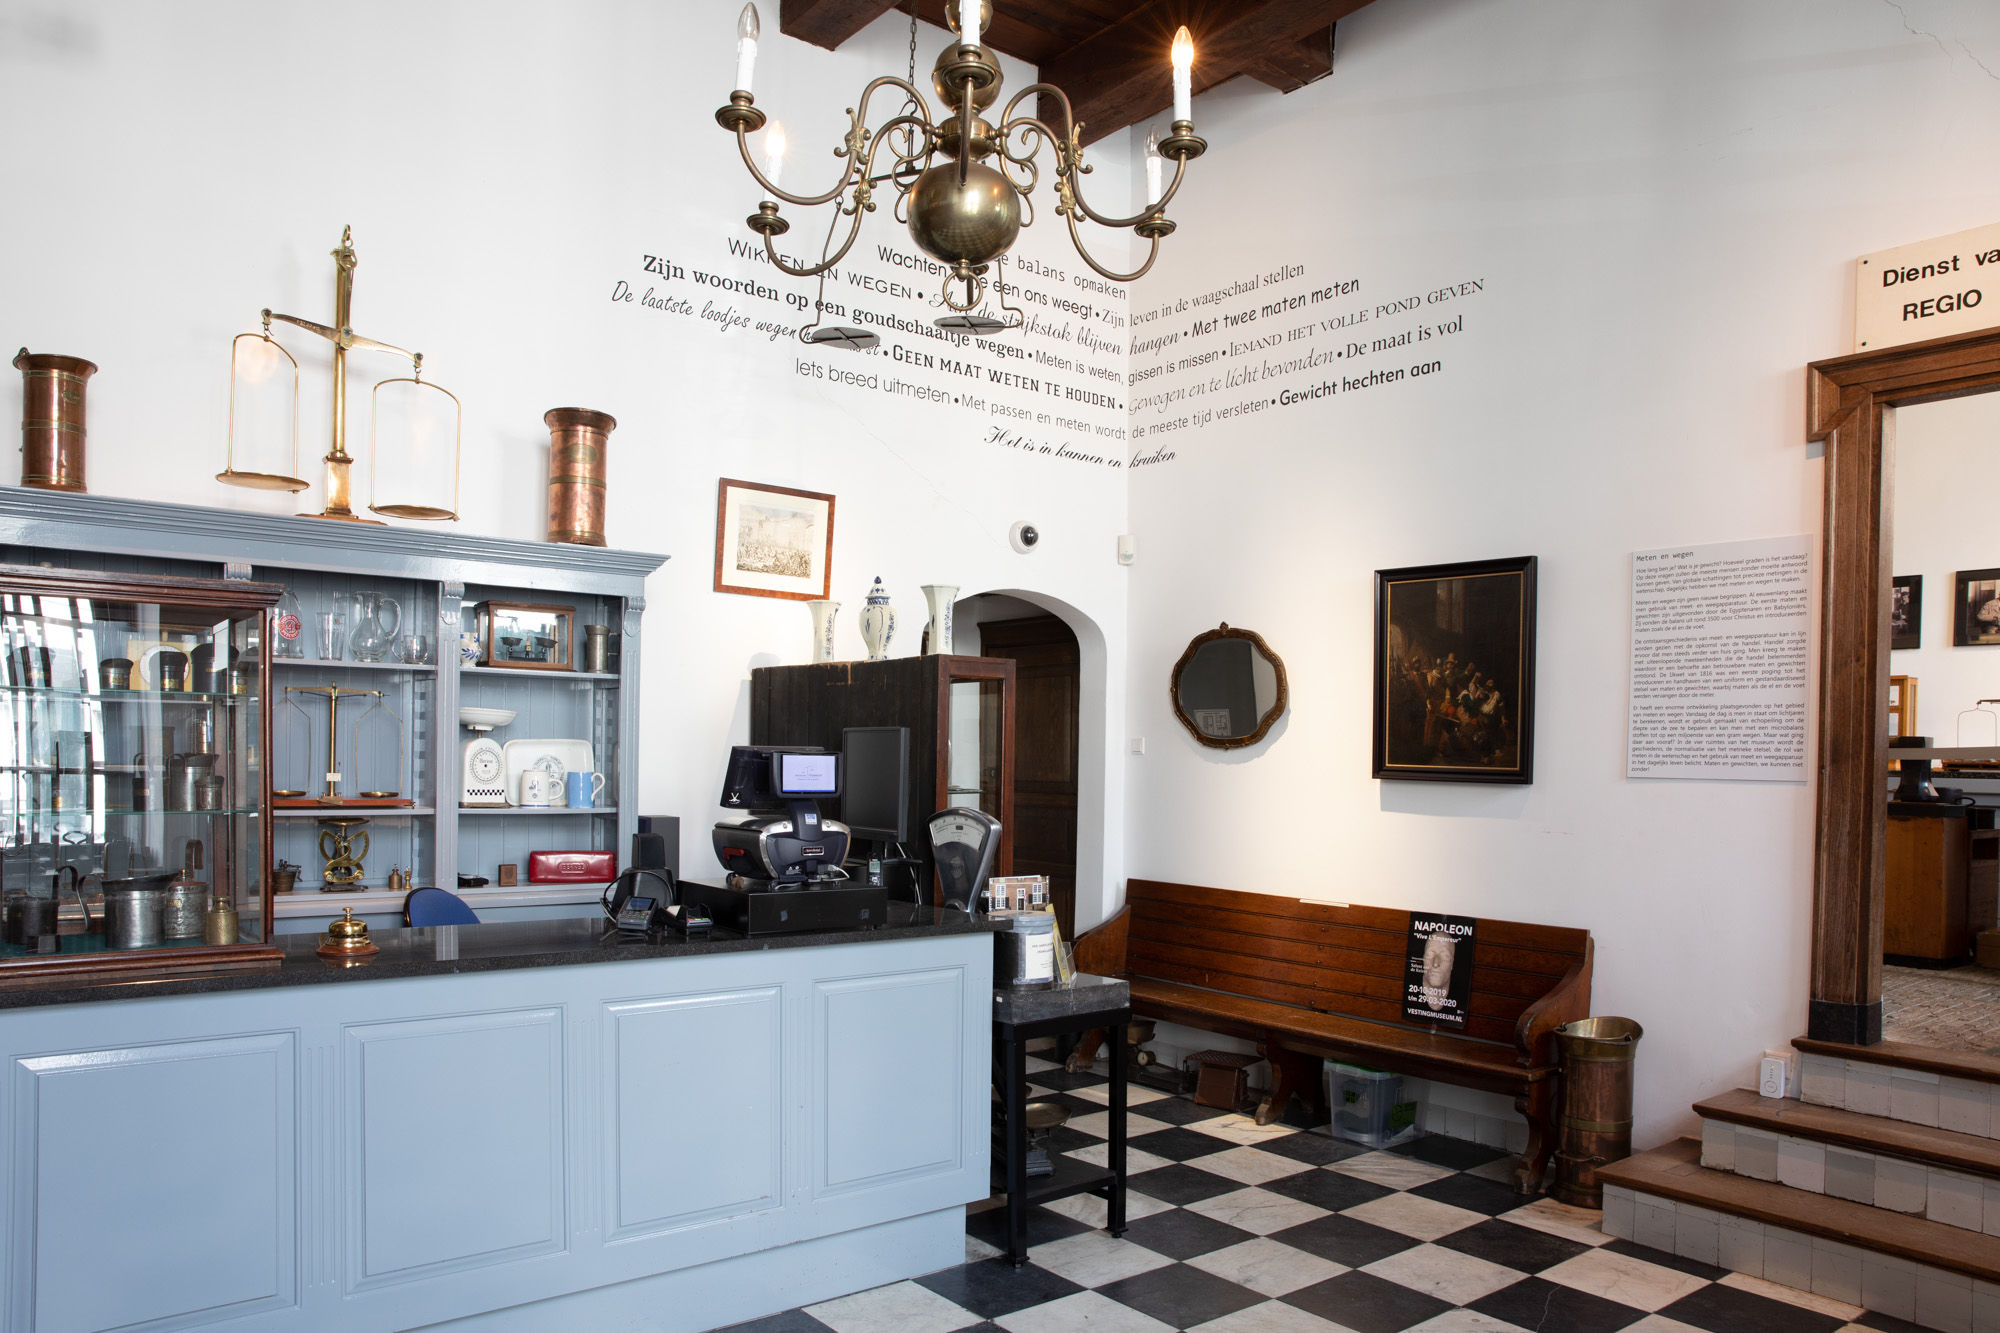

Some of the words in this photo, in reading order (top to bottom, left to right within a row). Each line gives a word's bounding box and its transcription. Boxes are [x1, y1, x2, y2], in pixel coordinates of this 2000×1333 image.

[878, 245, 946, 278] Wachten
[993, 278, 1020, 301] een
[1024, 290, 1048, 306] ons
[1052, 297, 1092, 320] weegt
[1102, 309, 1124, 329] Zijn
[1018, 255, 1065, 282] balans
[1074, 276, 1126, 300] opmaken
[1130, 310, 1158, 327] leven
[1162, 304, 1172, 317] in
[1176, 298, 1188, 313] de
[1192, 274, 1259, 307] waagschaal
[1264, 265, 1304, 286] stellen
[1883, 255, 1960, 287] Dienst
[644, 255, 685, 281] Zijn
[692, 271, 779, 301] woorden
[786, 293, 808, 312] op
[815, 298, 846, 317] een
[852, 308, 970, 346] goudschaaltje
[976, 338, 1024, 360] wegen
[1036, 350, 1072, 371] Meten
[1076, 360, 1085, 374] is
[1088, 366, 1123, 385] weten,
[848, 272, 911, 300] WEGEN
[978, 302, 996, 320] de
[1077, 326, 1122, 355] blijven
[1130, 332, 1178, 356] hangen
[1192, 318, 1218, 338] Met
[1223, 310, 1256, 328] twee
[1262, 295, 1306, 318] maten
[1312, 279, 1359, 304] meten
[1902, 289, 1982, 321] REGIO
[612, 280, 634, 302] De
[641, 287, 693, 316] laatste
[701, 300, 750, 332] loodjes
[756, 322, 796, 342] wegen
[893, 344, 934, 369] GEEN
[940, 358, 982, 379] MAAT
[988, 369, 1039, 392] WETEN
[1045, 382, 1060, 397] TE
[1066, 387, 1115, 410] HOUDEN
[1128, 366, 1162, 387] gissen
[1166, 361, 1175, 374] is
[1179, 350, 1219, 370] missen
[1288, 324, 1316, 342] HET
[1320, 310, 1369, 332] VOLLE
[1376, 296, 1421, 318] POND
[1427, 278, 1484, 304] GEVEN
[1129, 388, 1185, 416] Gewogen
[1189, 383, 1205, 398] en
[1209, 378, 1222, 392] te
[1261, 347, 1334, 380] bevonden
[1346, 343, 1367, 358] De
[1372, 331, 1411, 352] maat
[1418, 325, 1431, 341] is
[1437, 315, 1462, 336] vol
[796, 358, 823, 379] Iets
[829, 365, 878, 390] breed
[884, 378, 950, 404] uitmeten
[962, 393, 986, 411] Met
[991, 403, 1032, 421] passen
[1037, 413, 1051, 424] en
[1056, 417, 1091, 432] meten
[1095, 425, 1126, 441] wordt
[1132, 425, 1145, 439] de
[1150, 417, 1188, 435] meeste
[1193, 409, 1212, 428] tijd
[1216, 399, 1268, 420] versleten
[1280, 381, 1337, 406] Gewicht
[1343, 369, 1404, 392] hechten
[1411, 361, 1441, 377] aan
[984, 426, 1022, 448] Het
[1023, 439, 1034, 452] is
[1039, 442, 1051, 454] in
[1055, 443, 1103, 464] kannen
[1108, 460, 1121, 468] en
[1128, 447, 1175, 468] kruiken
[1672, 551, 1693, 559] wegen
[1414, 920, 1472, 936] NAPOLEON
[1407, 1008, 1463, 1022] VESTINGMUSEUM.NL
[1408, 984, 1446, 996] 20-10-2019
[1418, 995, 1457, 1008] 29-03-2020
